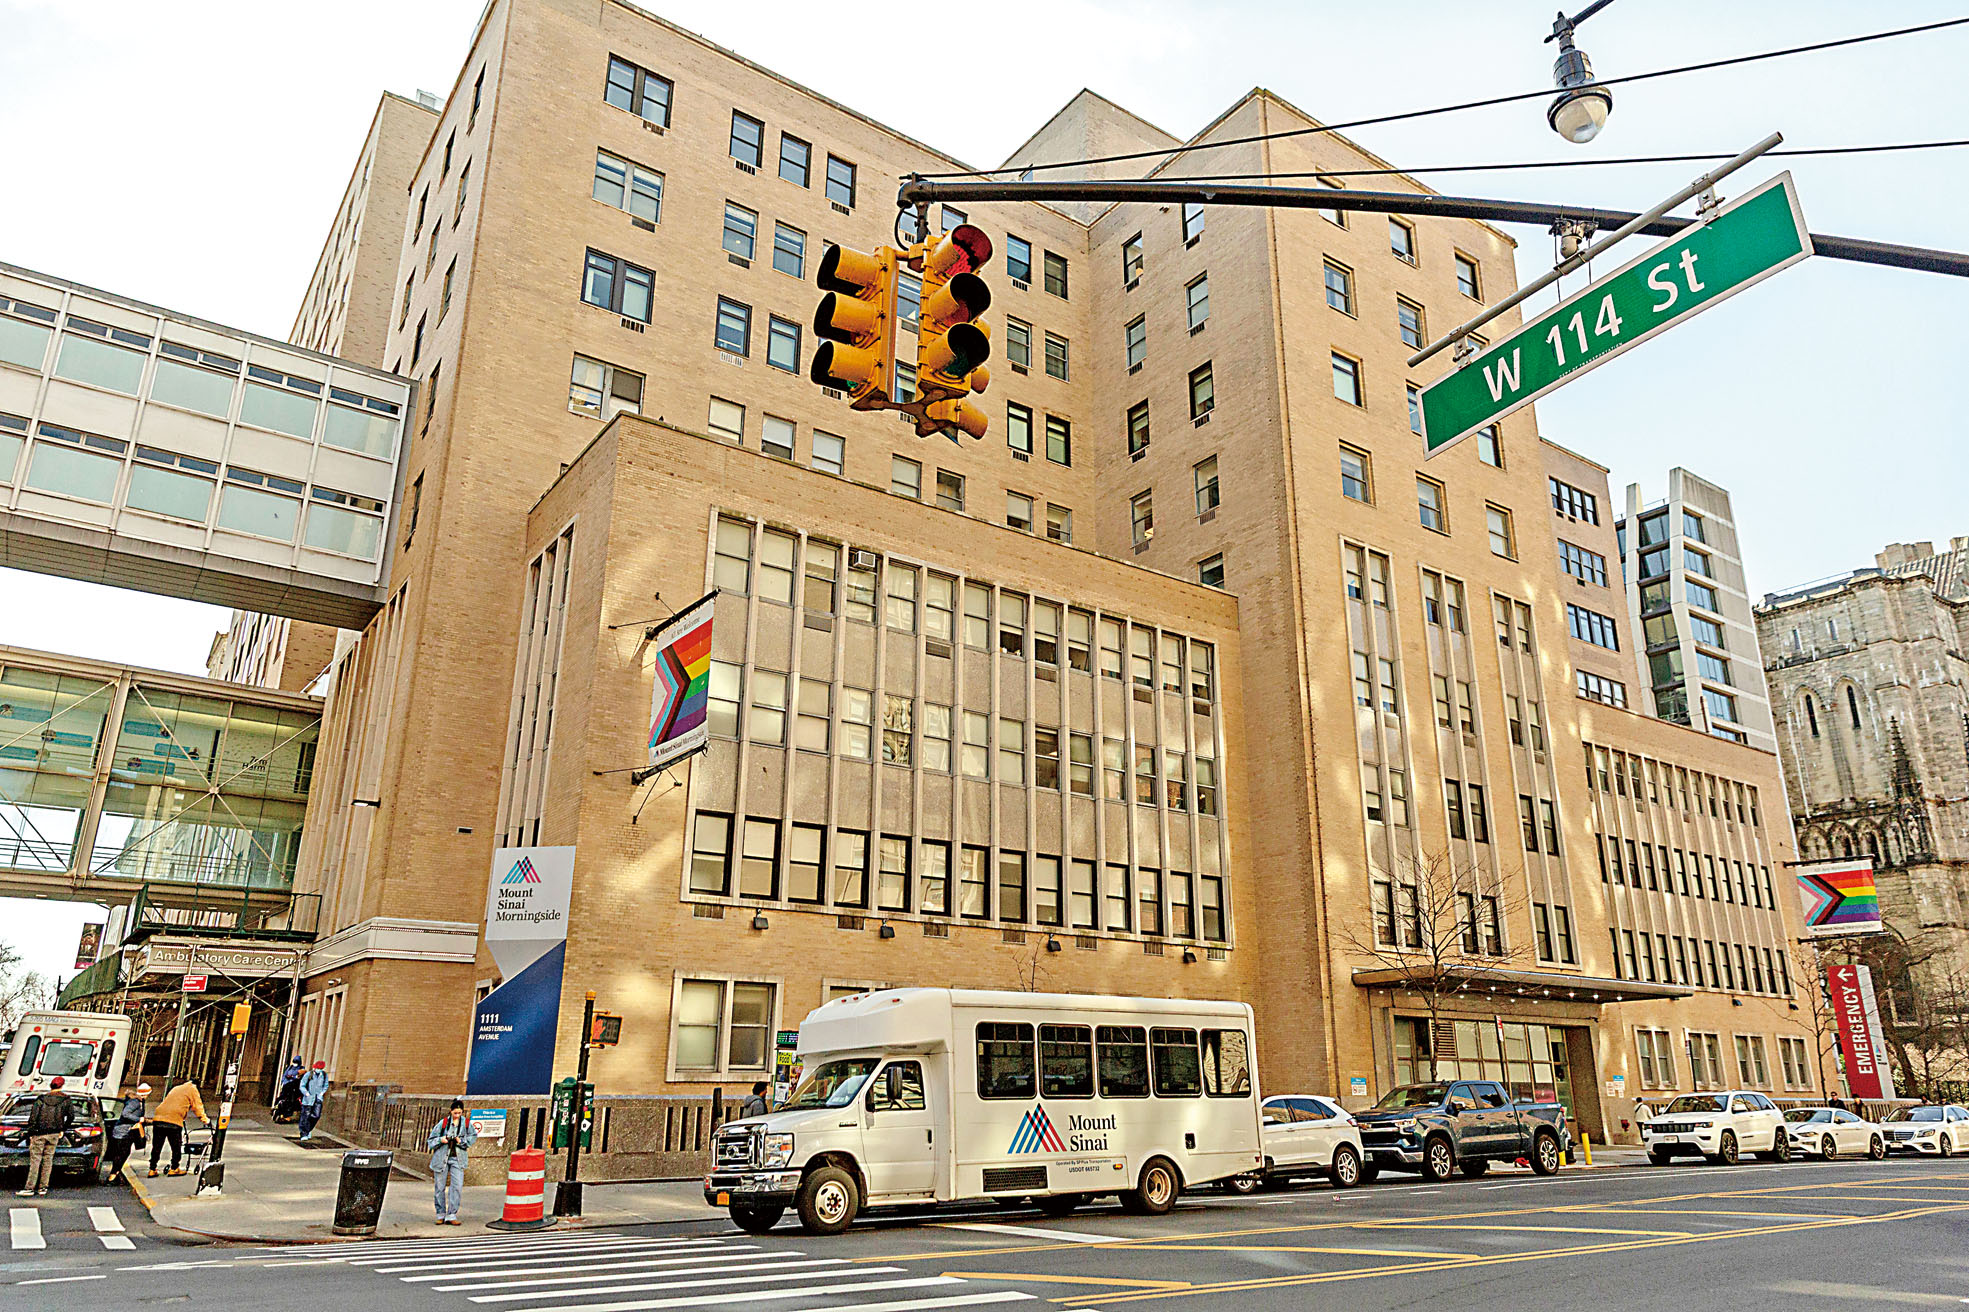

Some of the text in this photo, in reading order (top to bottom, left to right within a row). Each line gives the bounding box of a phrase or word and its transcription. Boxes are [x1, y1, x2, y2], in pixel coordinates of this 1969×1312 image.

[1482, 248, 1705, 403] W 114 St
[498, 888, 533, 898] Mount
[497, 899, 526, 910] Sinai
[495, 909, 561, 924] Morningside
[232, 953, 262, 965] Care
[480, 1013, 500, 1024] 1111
[1842, 986, 1874, 1074] EMERGENCY
[1068, 1114, 1117, 1131] Mount
[1070, 1133, 1108, 1152] Sinai
